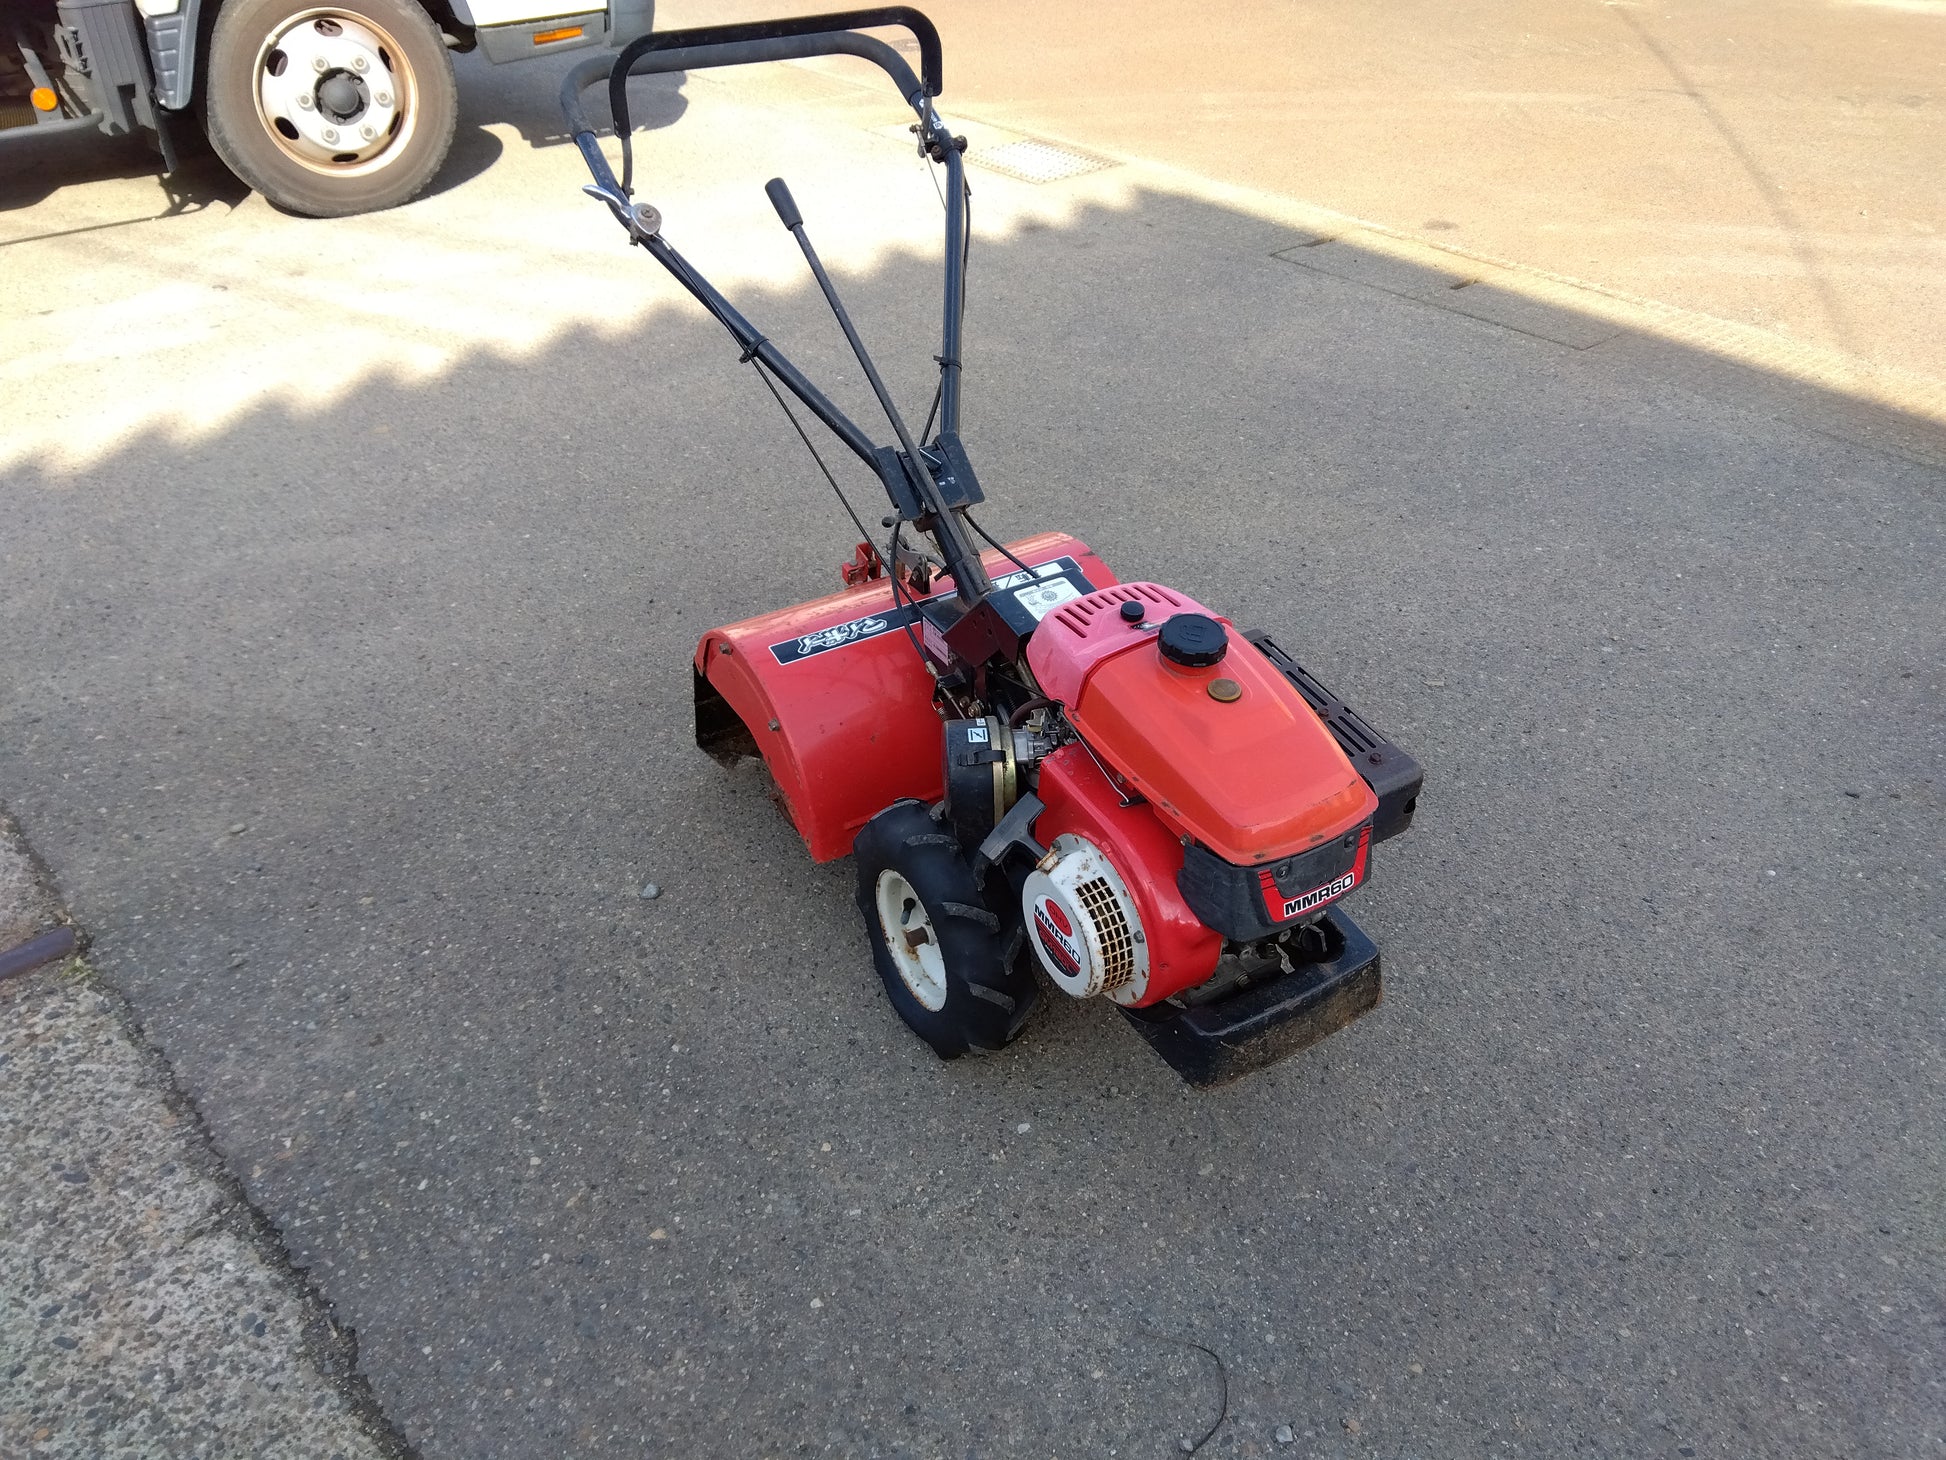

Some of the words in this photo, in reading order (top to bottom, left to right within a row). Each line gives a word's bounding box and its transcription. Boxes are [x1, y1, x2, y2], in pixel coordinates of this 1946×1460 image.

[1284, 873, 1354, 916] MMR60
[1034, 903, 1081, 965] MMR60
[1049, 905, 1068, 929] OHV
